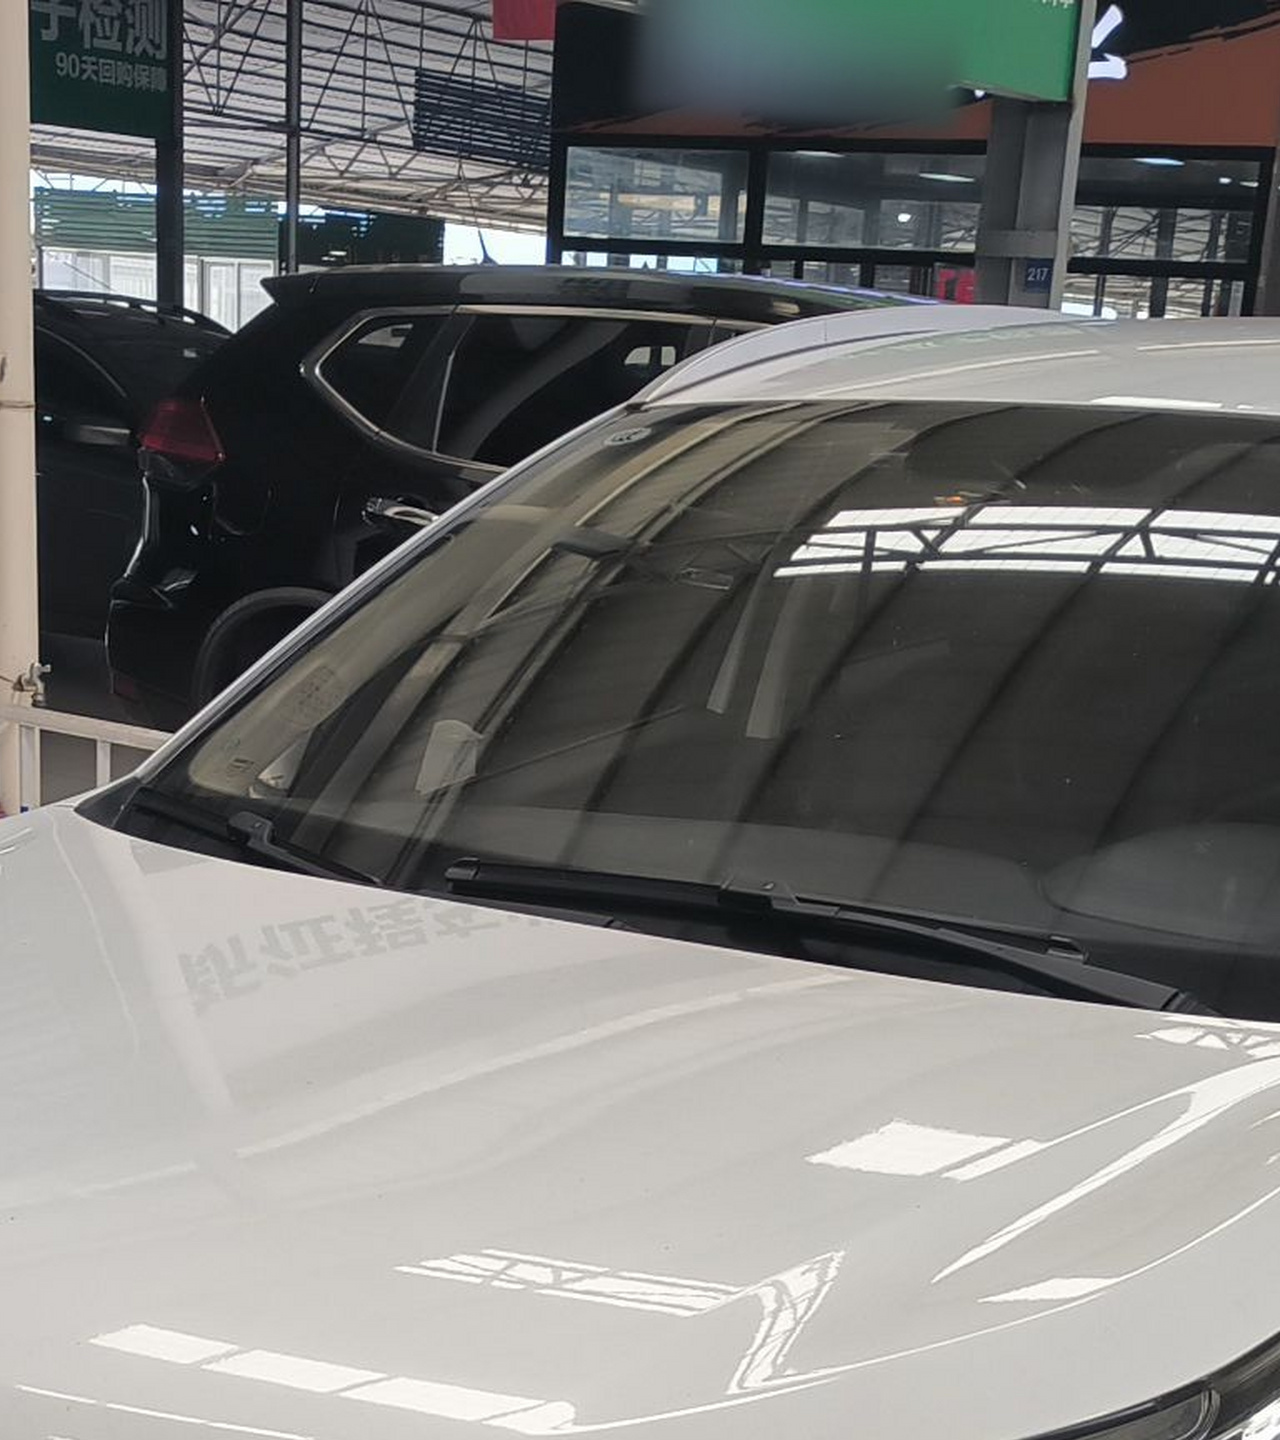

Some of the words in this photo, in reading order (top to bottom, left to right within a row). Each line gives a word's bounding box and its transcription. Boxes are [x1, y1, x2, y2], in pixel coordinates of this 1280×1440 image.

[55, 52, 167, 92] 90天回购保障
[1027, 267, 1049, 281] 217
